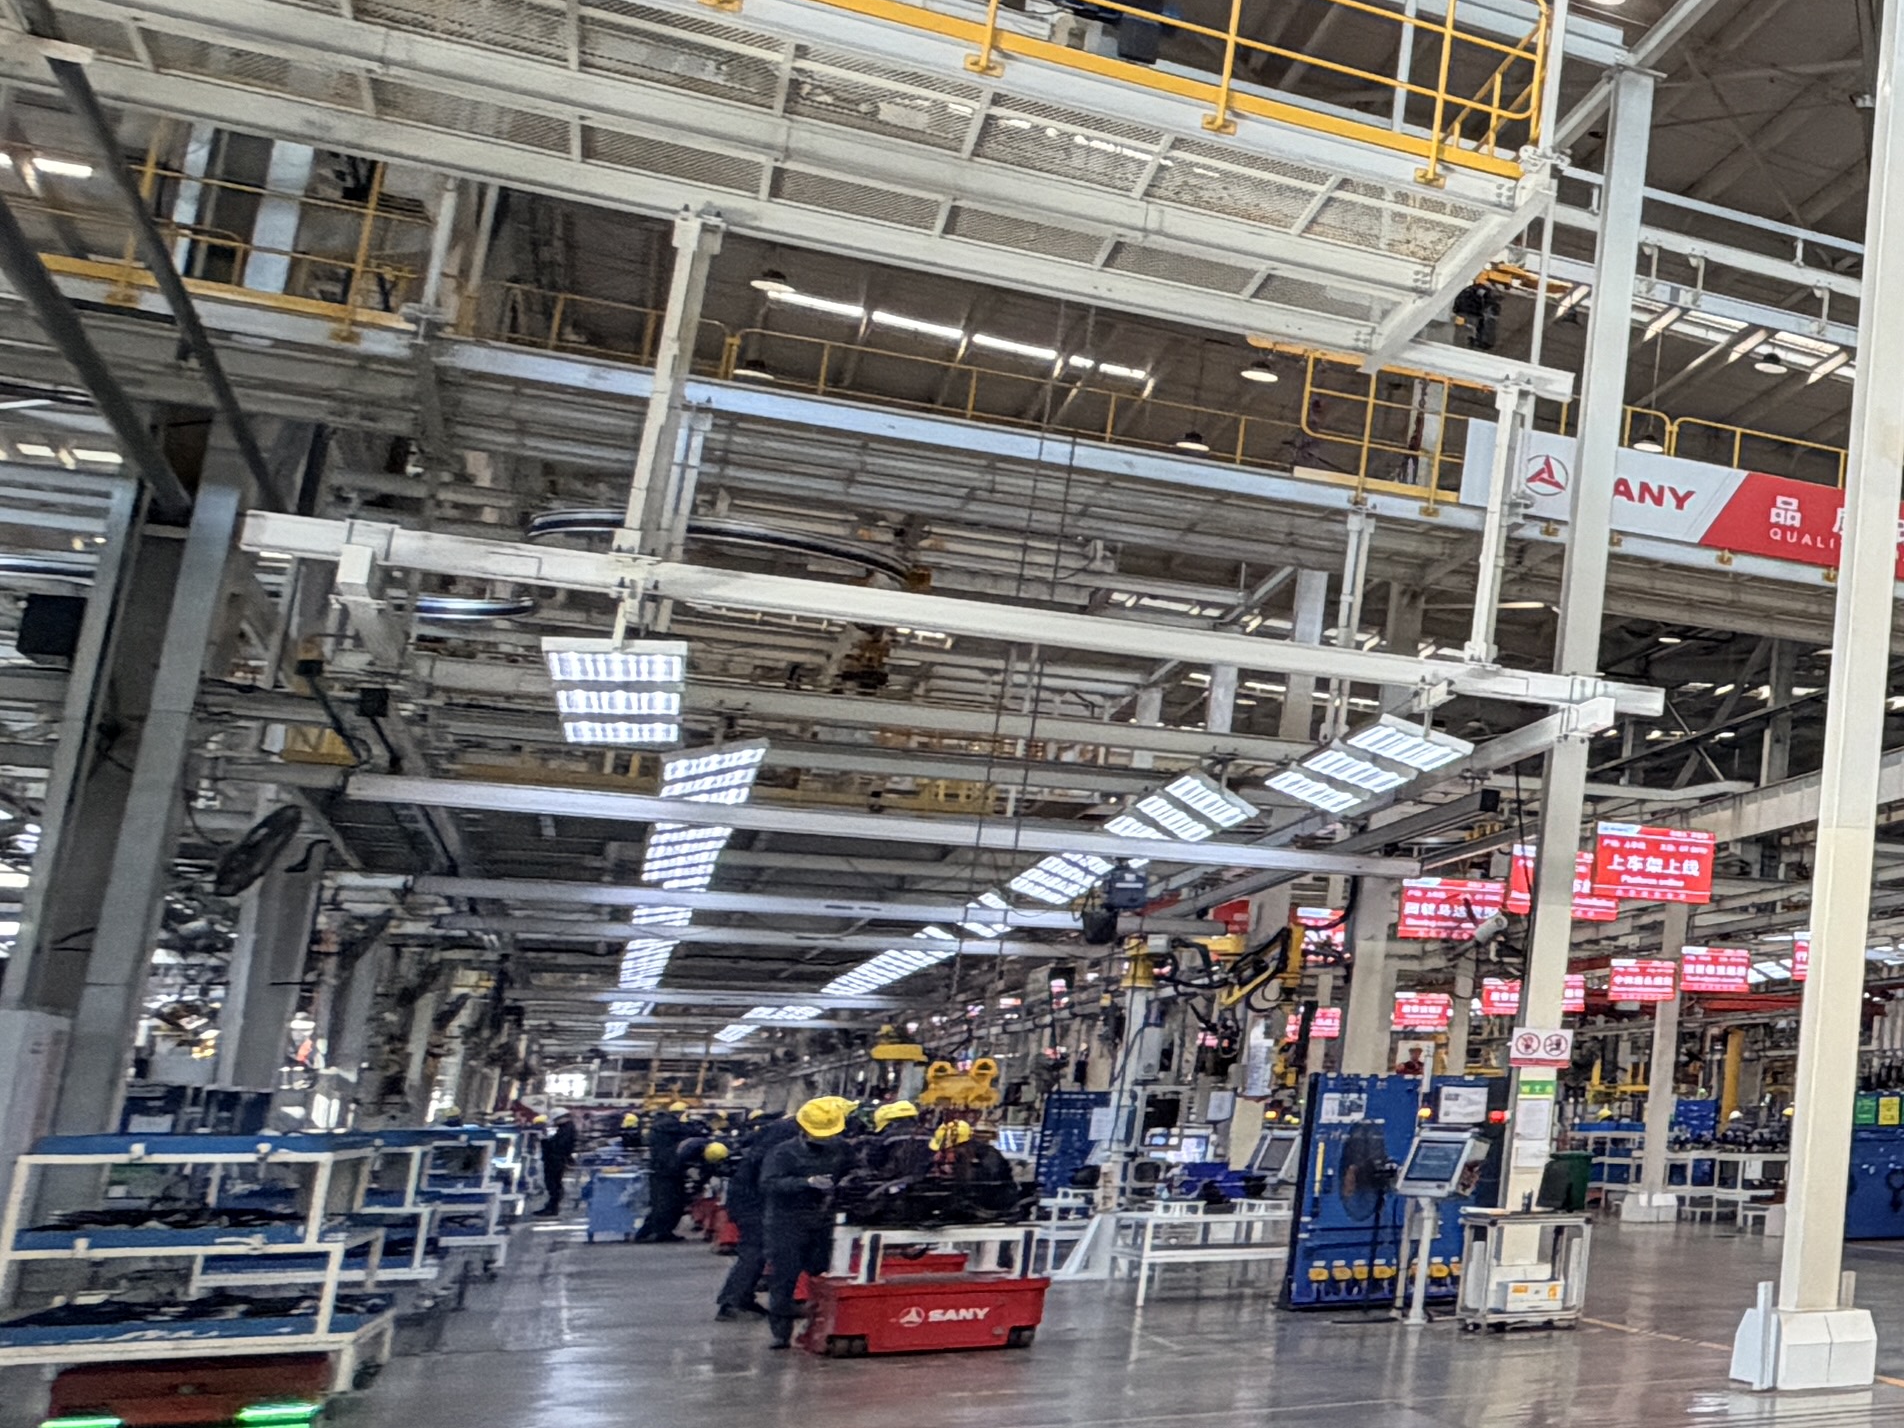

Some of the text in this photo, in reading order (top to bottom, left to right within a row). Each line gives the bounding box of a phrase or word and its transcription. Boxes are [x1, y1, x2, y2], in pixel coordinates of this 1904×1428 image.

[1614, 477, 1696, 511] ANY
[1769, 527, 1843, 550] QUALI
[927, 1306, 990, 1322] SANY
